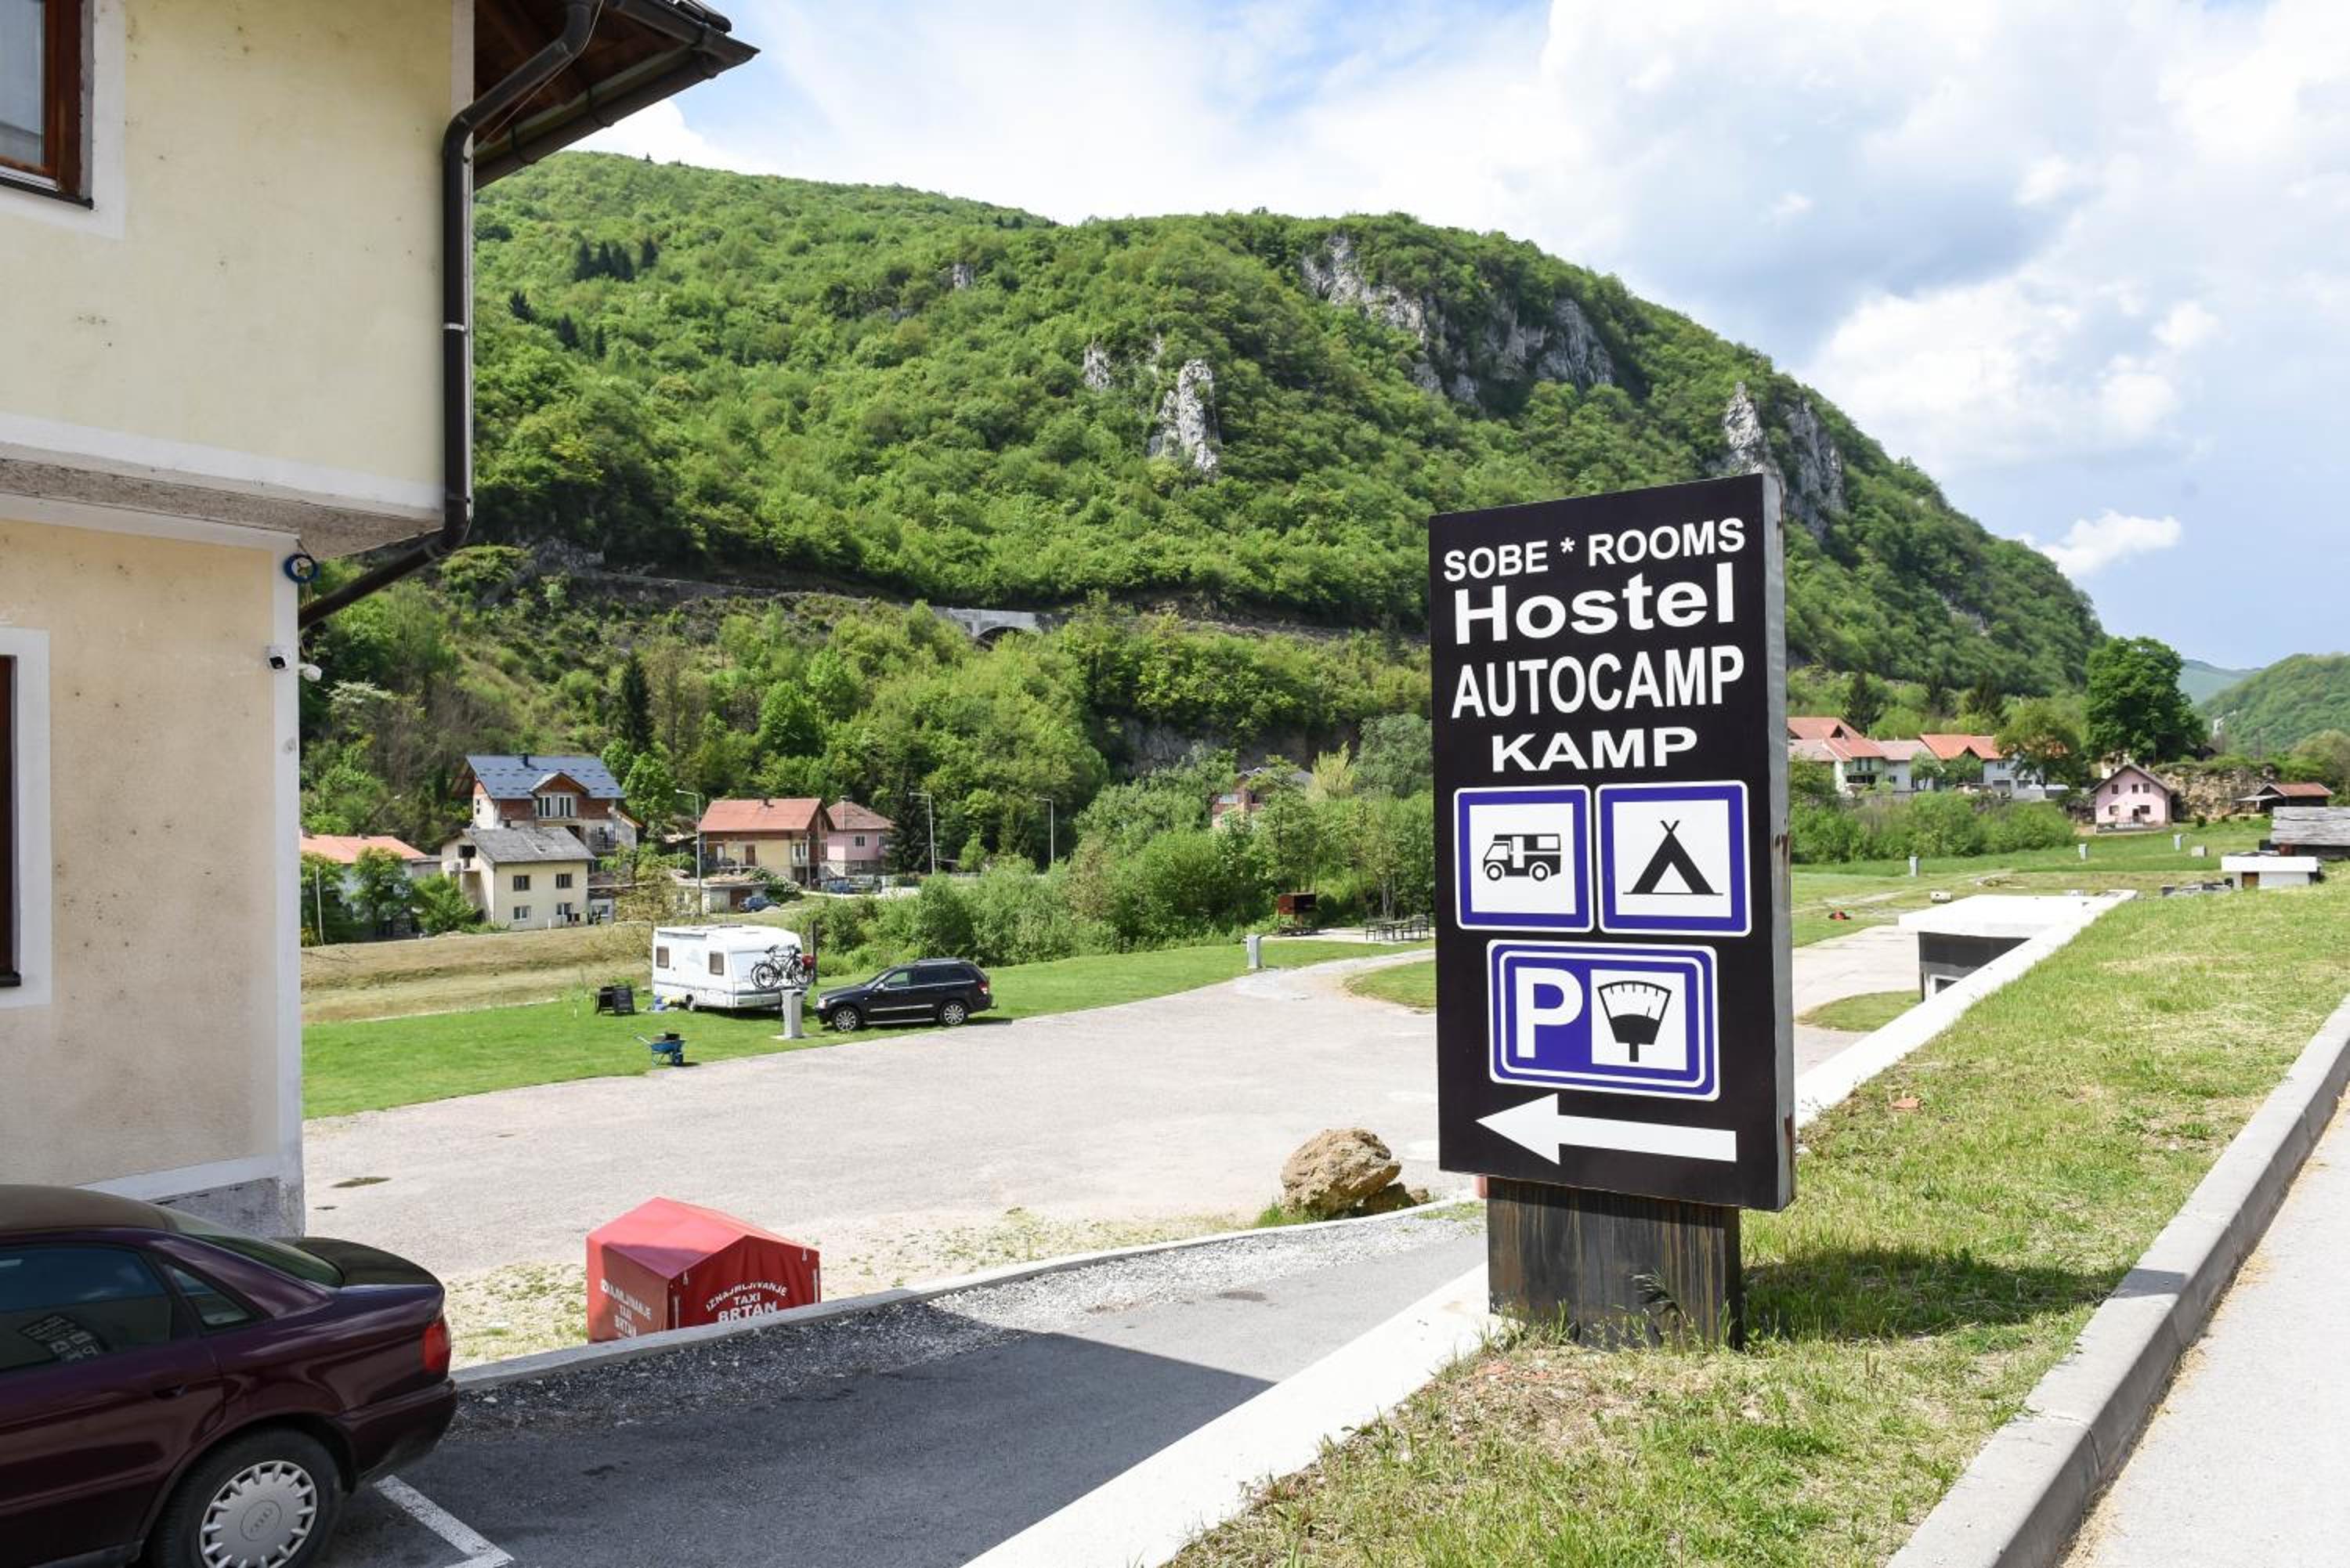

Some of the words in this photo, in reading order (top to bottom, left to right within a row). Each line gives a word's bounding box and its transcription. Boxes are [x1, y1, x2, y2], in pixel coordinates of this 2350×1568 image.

[1443, 540, 1549, 582] SOBE
[1588, 518, 1745, 566] ROOMS
[1455, 562, 1734, 645] Hostel
[1452, 645, 1744, 719] AUTOCAMP
[1492, 726, 1697, 772] KAMP
[1515, 966, 1583, 1059] P
[733, 1292, 761, 1306] TAXI
